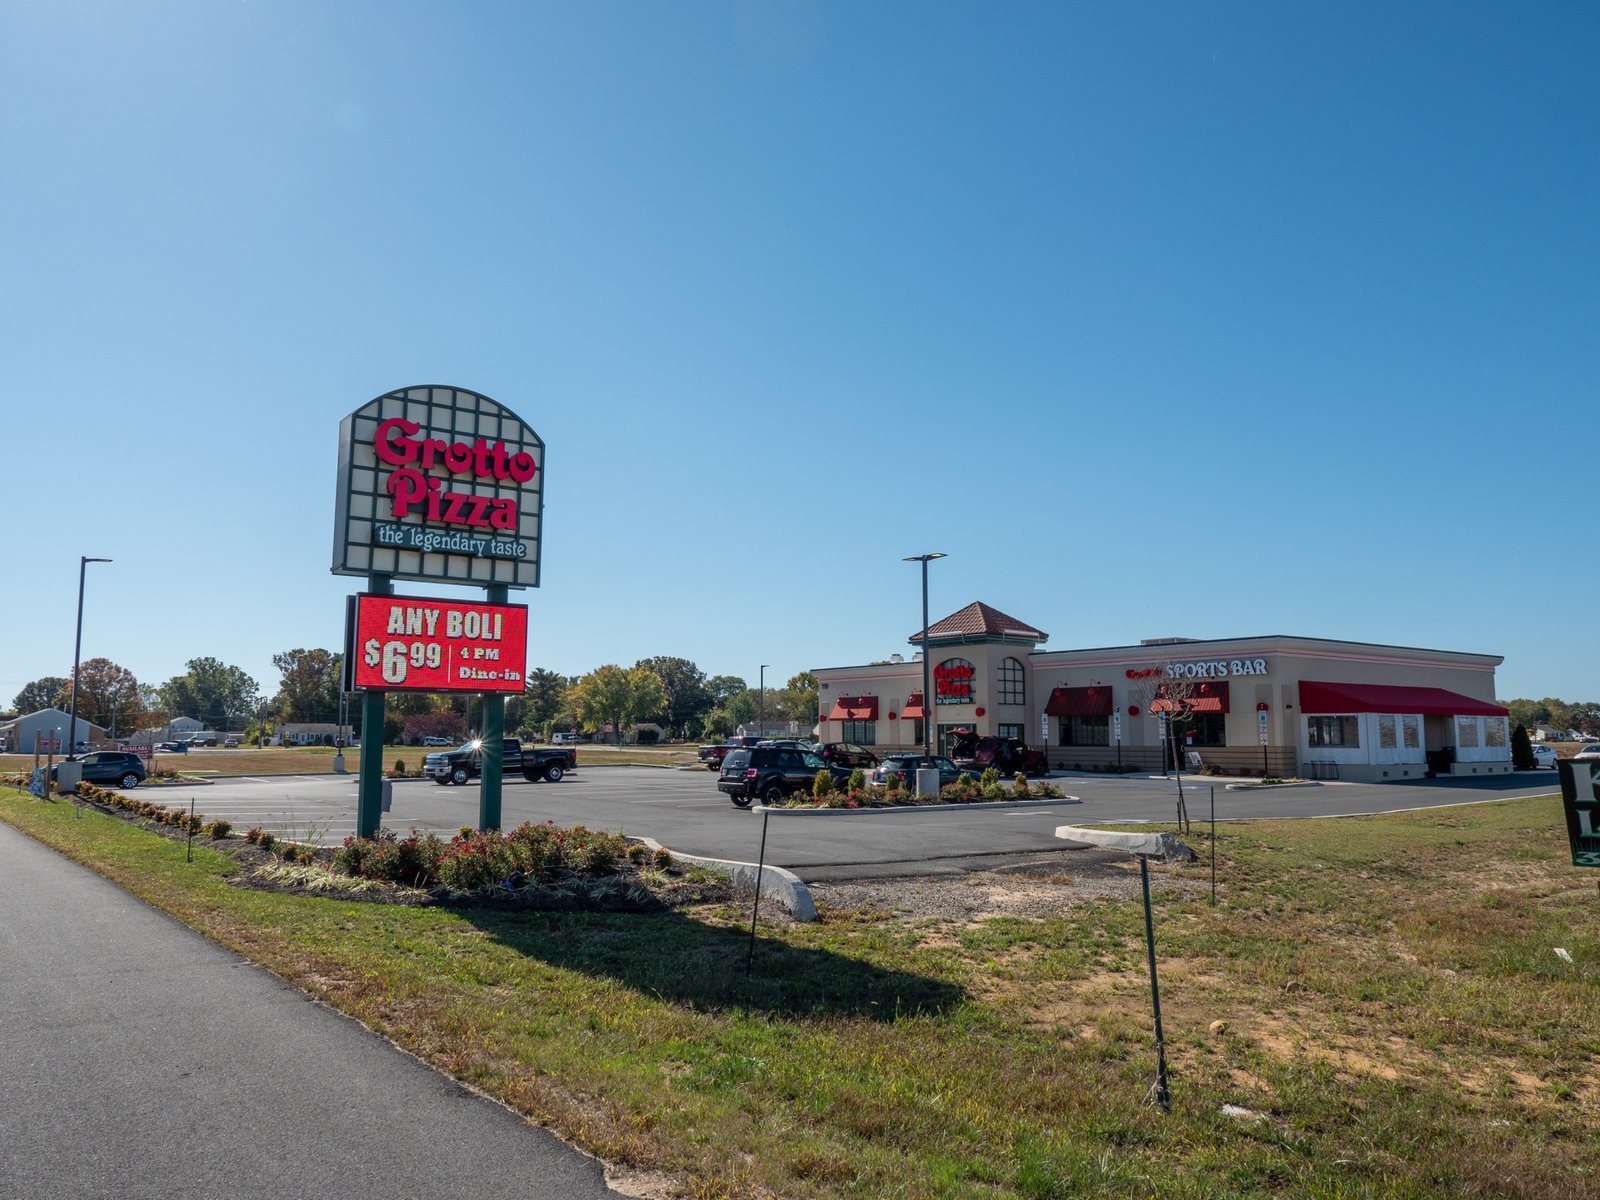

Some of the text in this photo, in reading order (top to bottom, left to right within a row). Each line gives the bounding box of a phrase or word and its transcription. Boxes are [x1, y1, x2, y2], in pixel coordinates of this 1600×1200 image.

[374, 417, 536, 483] Grotto
[386, 468, 517, 530] Pizza
[379, 526, 526, 557] the legendary taste
[387, 605, 502, 640] ANY BOLI
[460, 647, 499, 660] 4 PM
[1166, 662, 1228, 678] SPORTS
[1231, 659, 1268, 676] BAR
[459, 666, 520, 681] Dine-in
